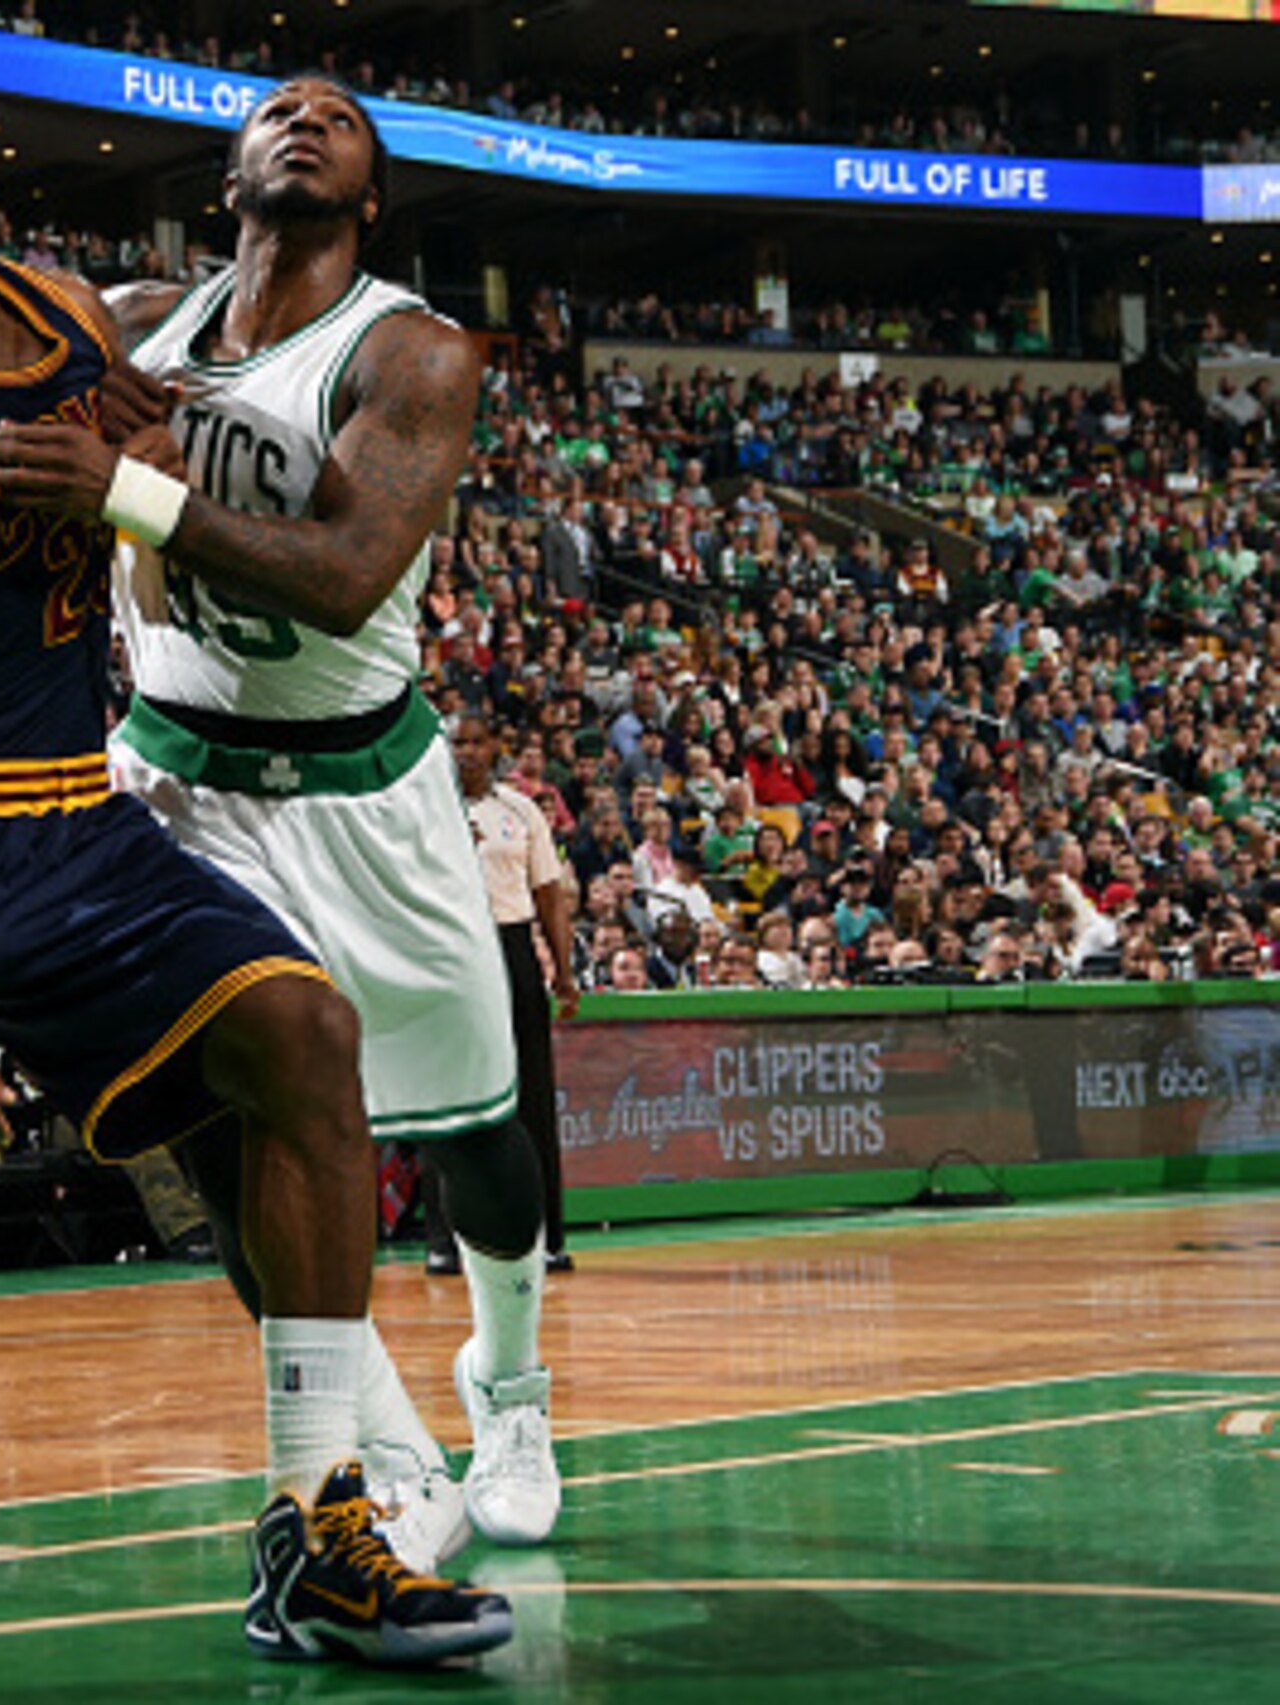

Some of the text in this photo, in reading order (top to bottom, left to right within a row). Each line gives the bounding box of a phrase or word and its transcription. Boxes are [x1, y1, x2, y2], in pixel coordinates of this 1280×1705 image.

[124, 66, 257, 118] FULL OF
[834, 158, 1049, 200] FULL OF LIFE
[715, 1042, 884, 1098] CLIPPERS
[1076, 1061, 1147, 1108] NEXT
[770, 1100, 885, 1160] SPURS
